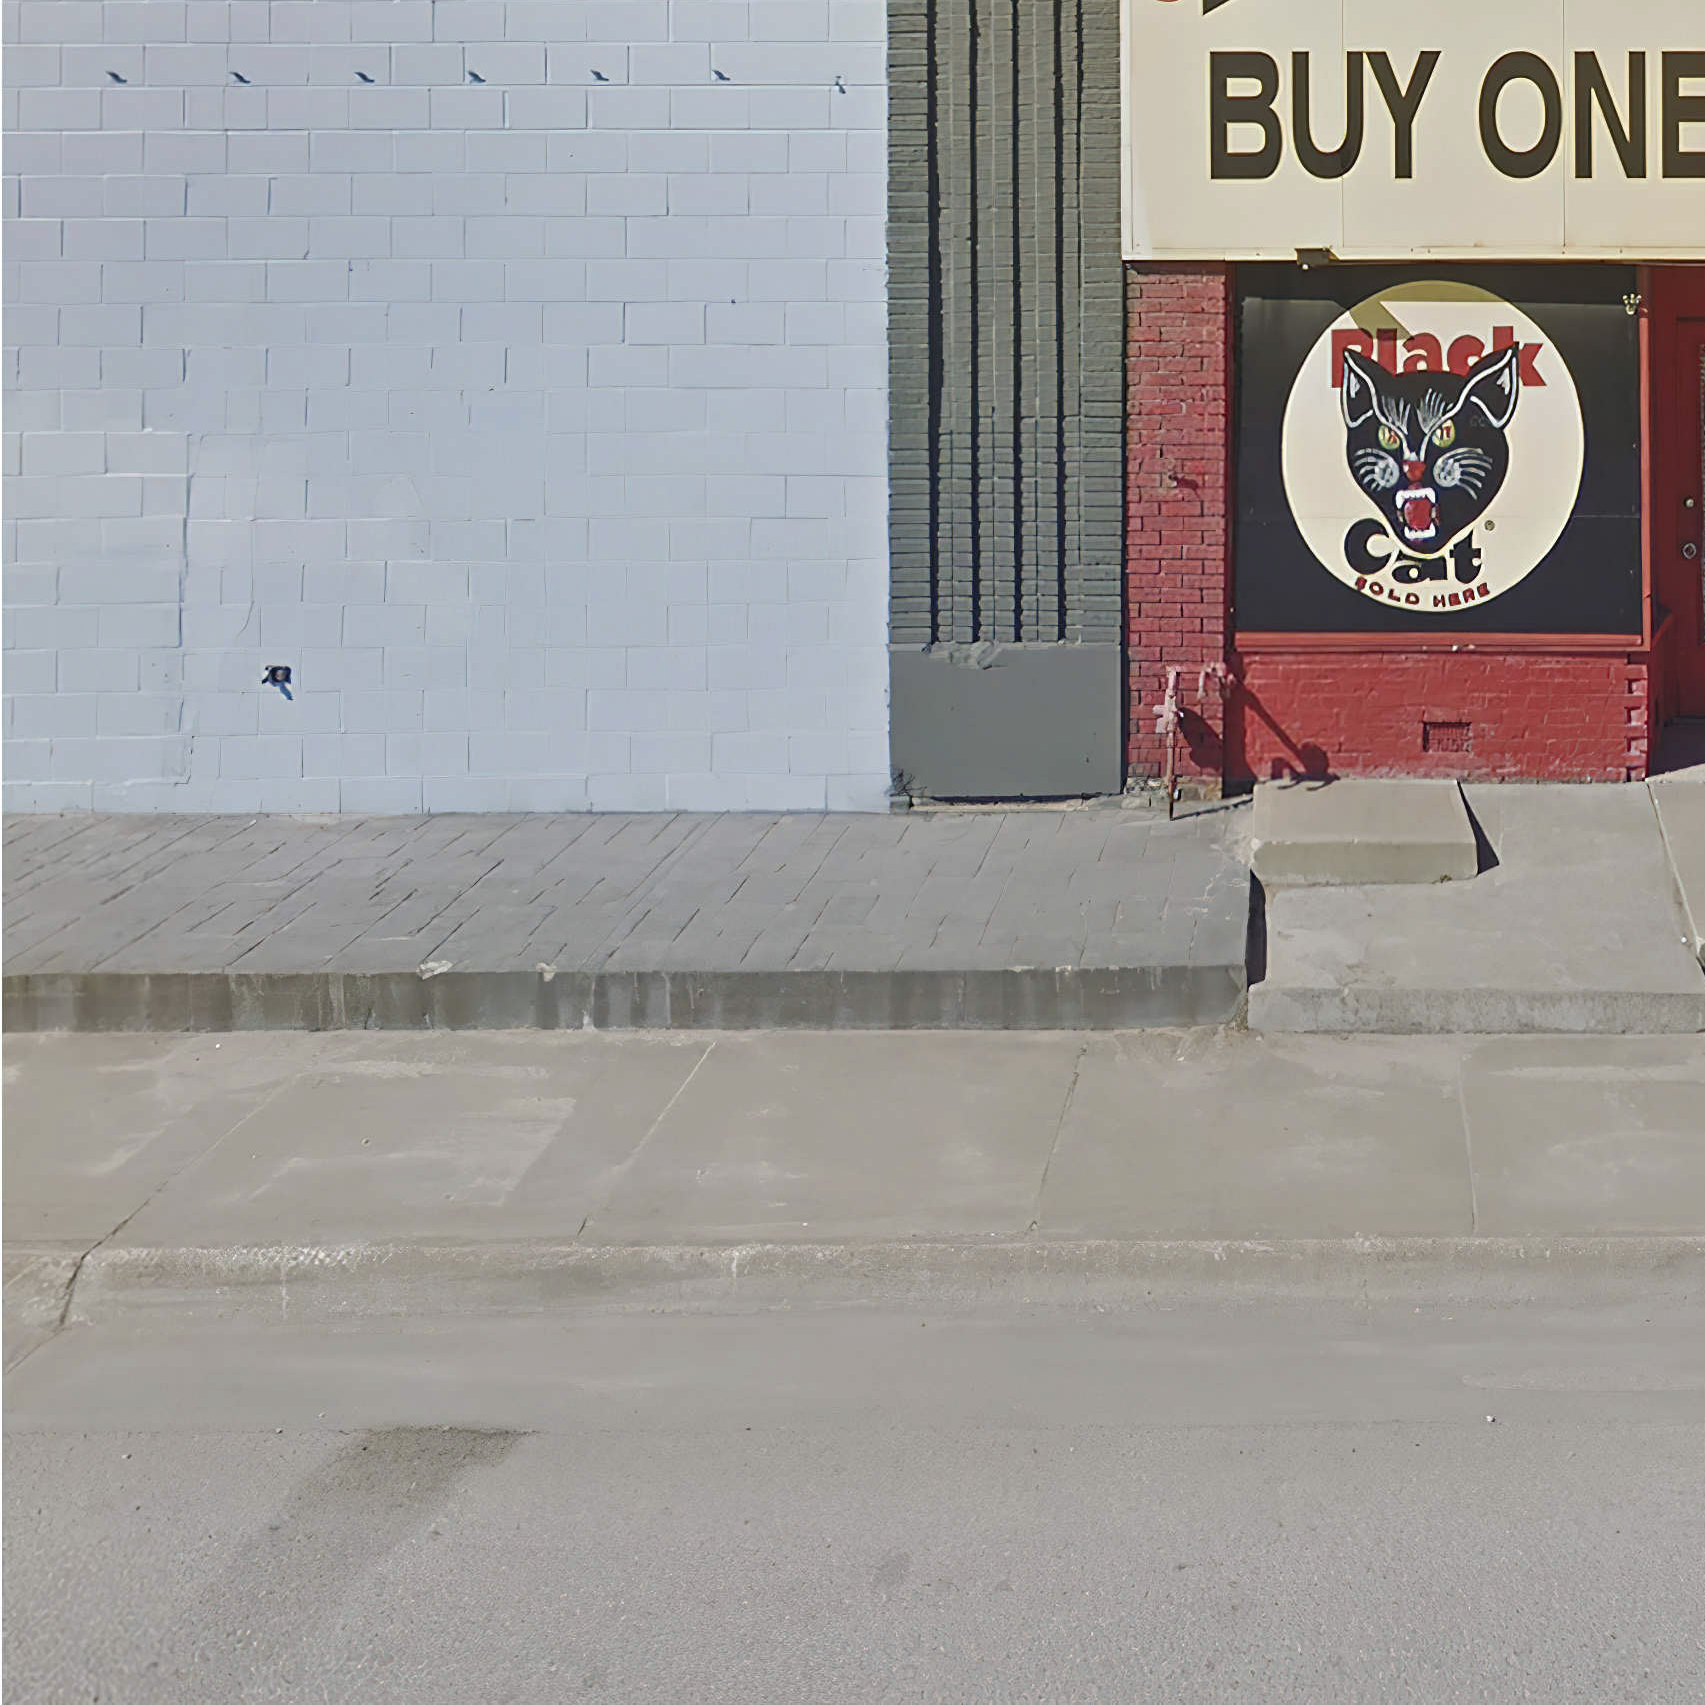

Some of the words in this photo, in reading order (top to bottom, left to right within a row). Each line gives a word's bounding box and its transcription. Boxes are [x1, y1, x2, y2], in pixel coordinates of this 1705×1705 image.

[1210, 50, 1442, 181] BUY
[1344, 518, 1482, 584] Cat
[1355, 576, 1420, 605] SOLD
[1433, 583, 1490, 607] HERE
